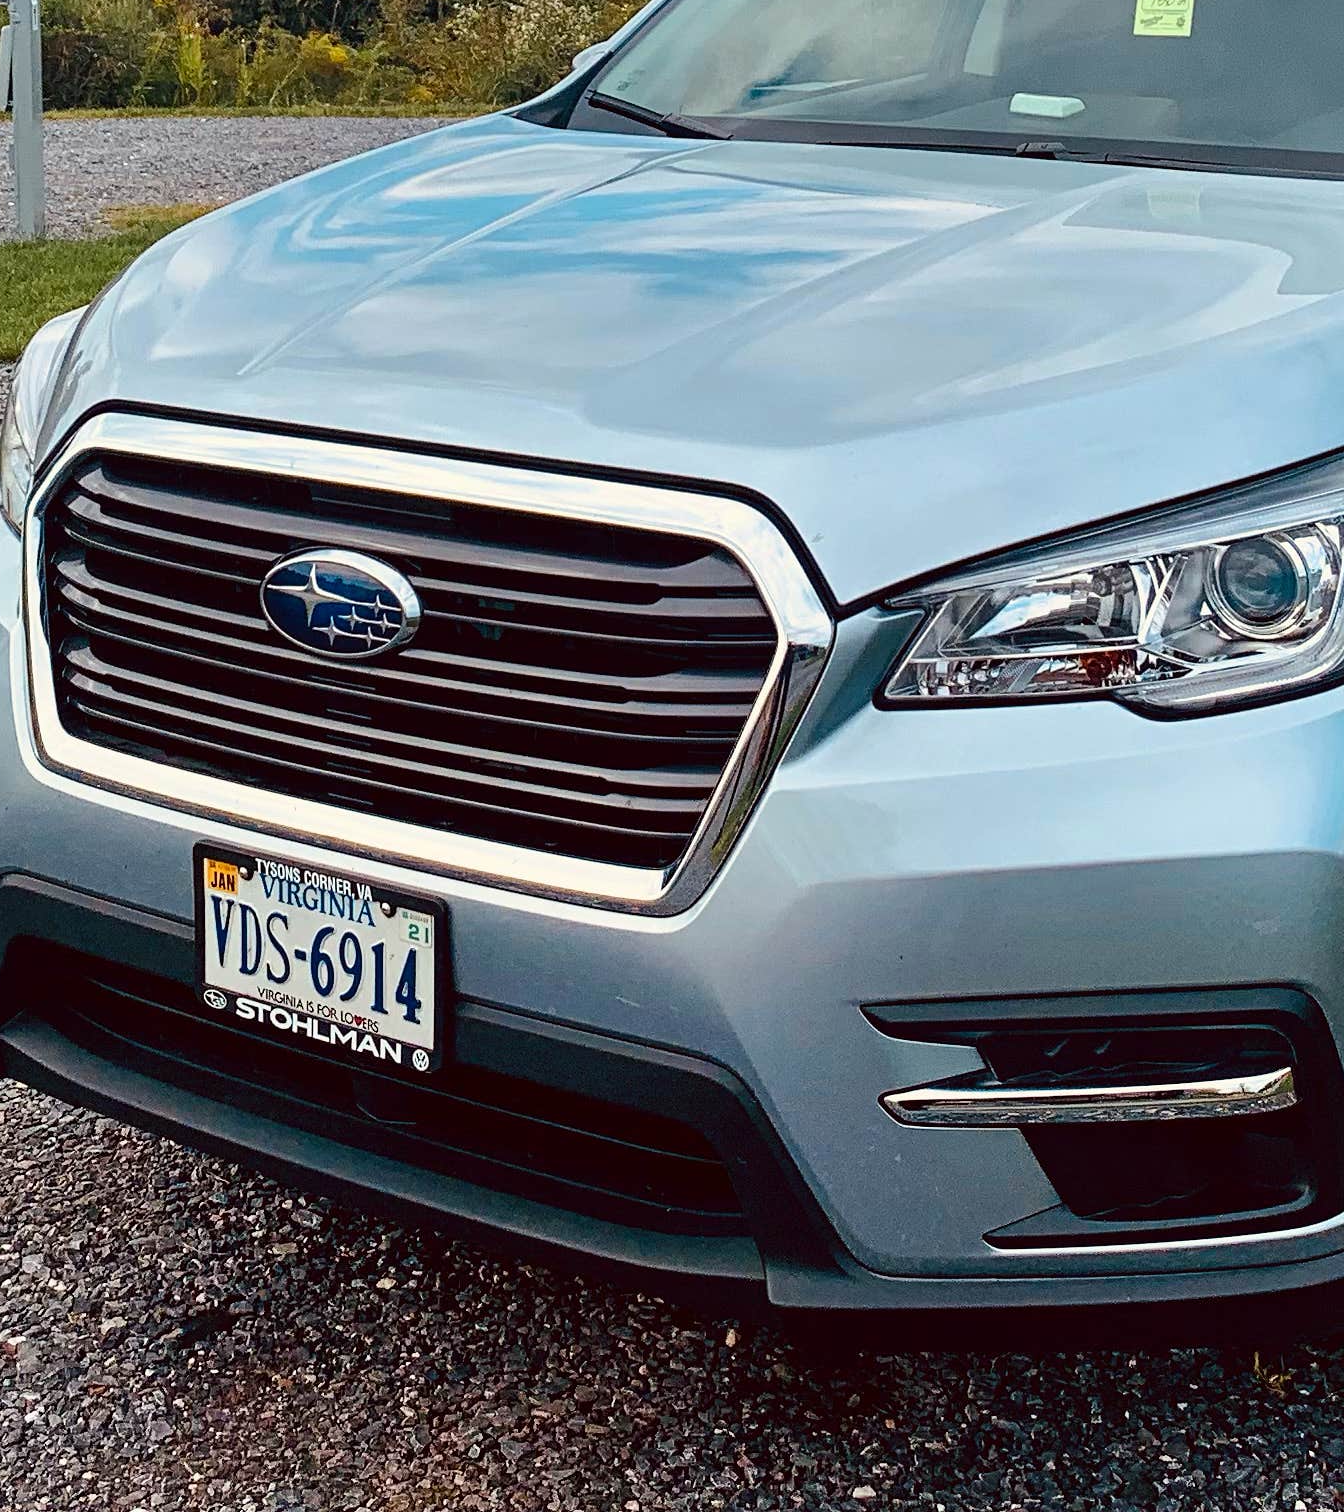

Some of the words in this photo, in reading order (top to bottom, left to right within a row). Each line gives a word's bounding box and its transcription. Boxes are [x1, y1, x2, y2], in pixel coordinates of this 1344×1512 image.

[211, 871, 235, 892] JAN
[255, 858, 301, 883] TYSONS
[356, 883, 373, 902] VA
[259, 873, 376, 927] VIRGINIA
[408, 923, 429, 944] 21
[210, 895, 421, 1025] VDS-6914
[257, 986, 304, 1010] VIRGINIA
[306, 1000, 315, 1014] IS
[317, 1004, 339, 1021] FOR
[235, 998, 402, 1064] STOHLMAN
